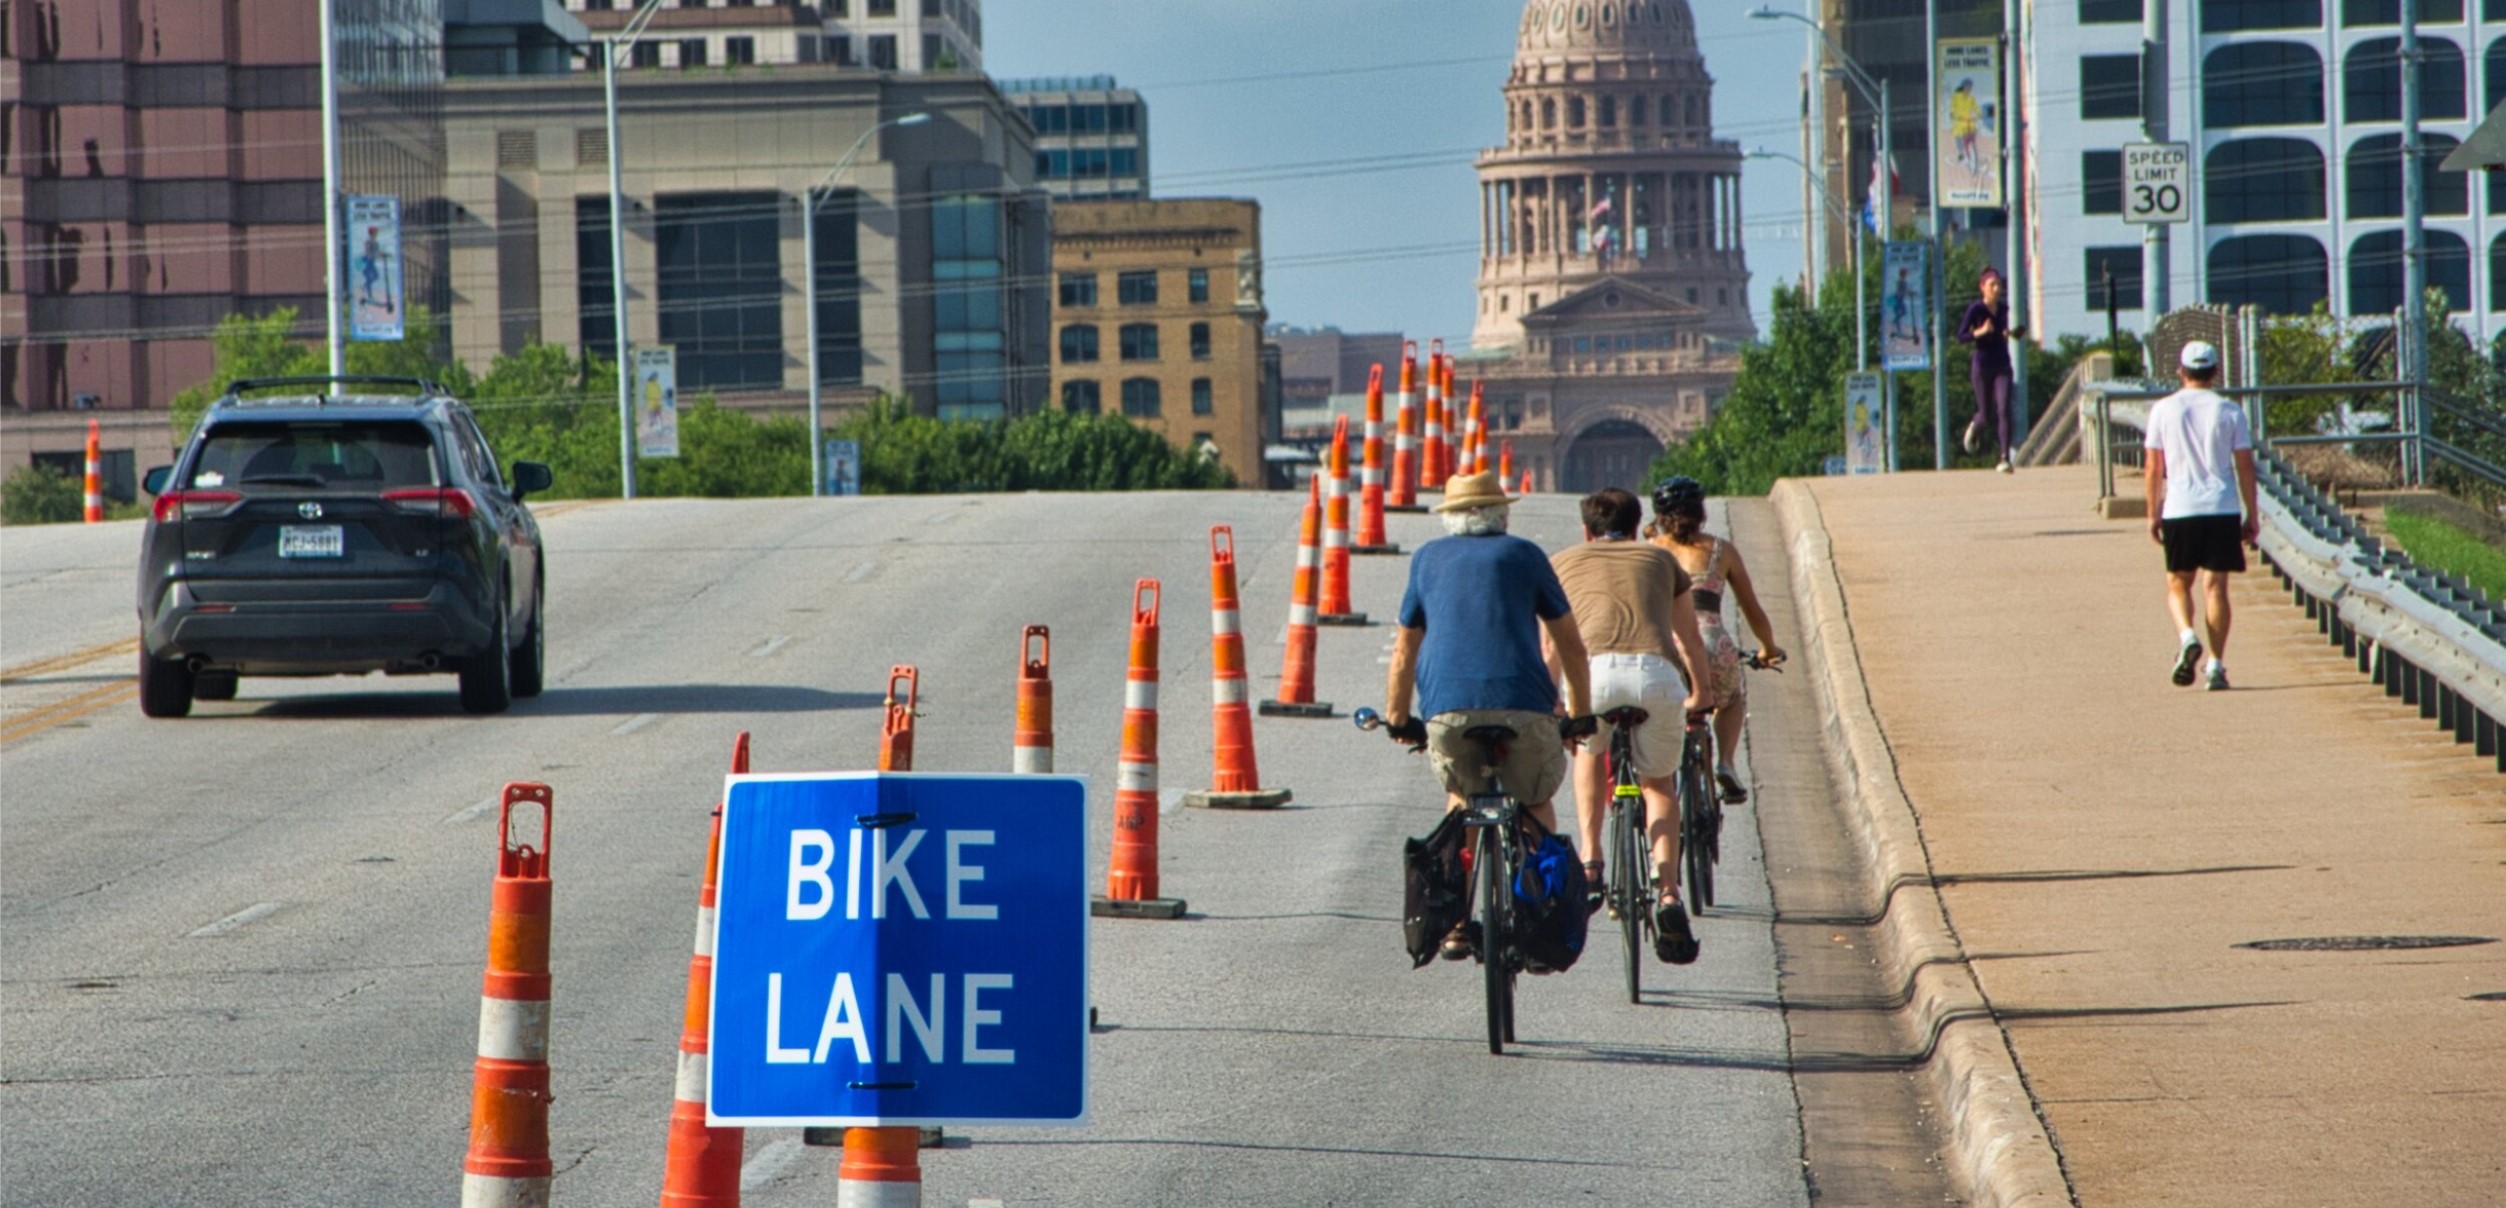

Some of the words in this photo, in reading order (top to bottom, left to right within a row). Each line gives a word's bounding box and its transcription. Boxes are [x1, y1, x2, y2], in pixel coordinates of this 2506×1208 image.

[2129, 150, 2184, 165] SPEED
[2134, 168, 2177, 181] LIMIT
[2133, 184, 2181, 214] 30
[786, 827, 999, 921] BIKE
[765, 972, 1016, 1065] LANE
